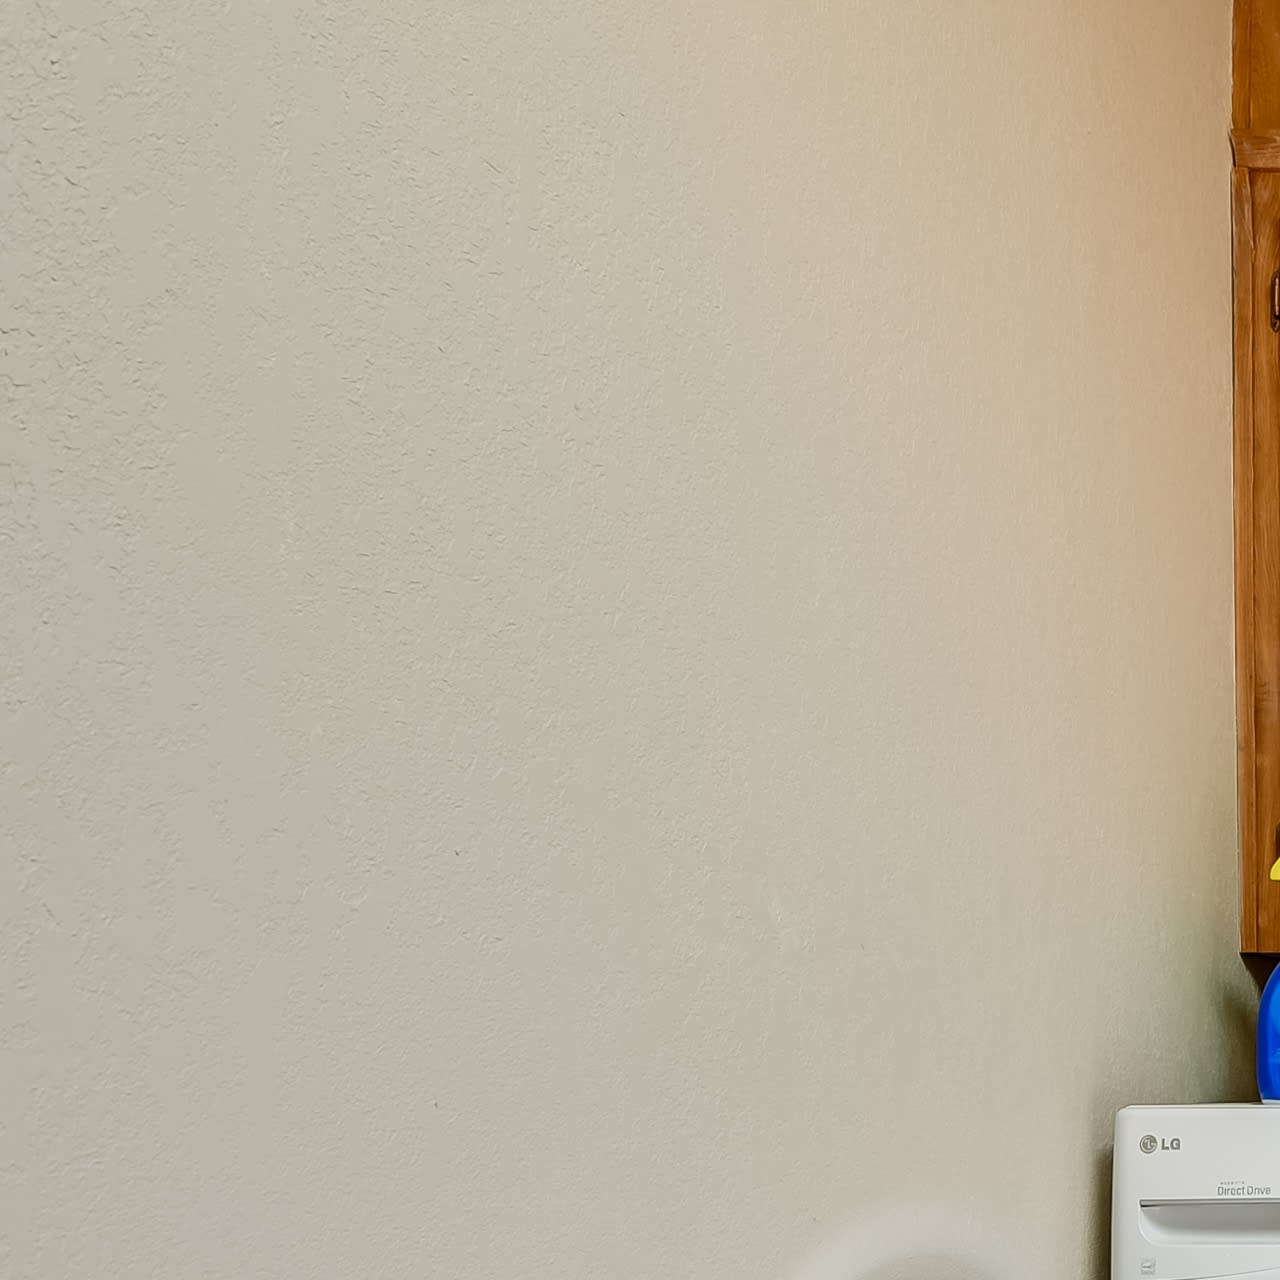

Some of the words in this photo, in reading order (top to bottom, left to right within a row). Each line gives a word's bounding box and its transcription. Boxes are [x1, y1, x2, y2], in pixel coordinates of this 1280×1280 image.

[1161, 1138, 1181, 1150] LG
[1217, 1186, 1245, 1196] Direct
[1246, 1186, 1271, 1195] Drive
